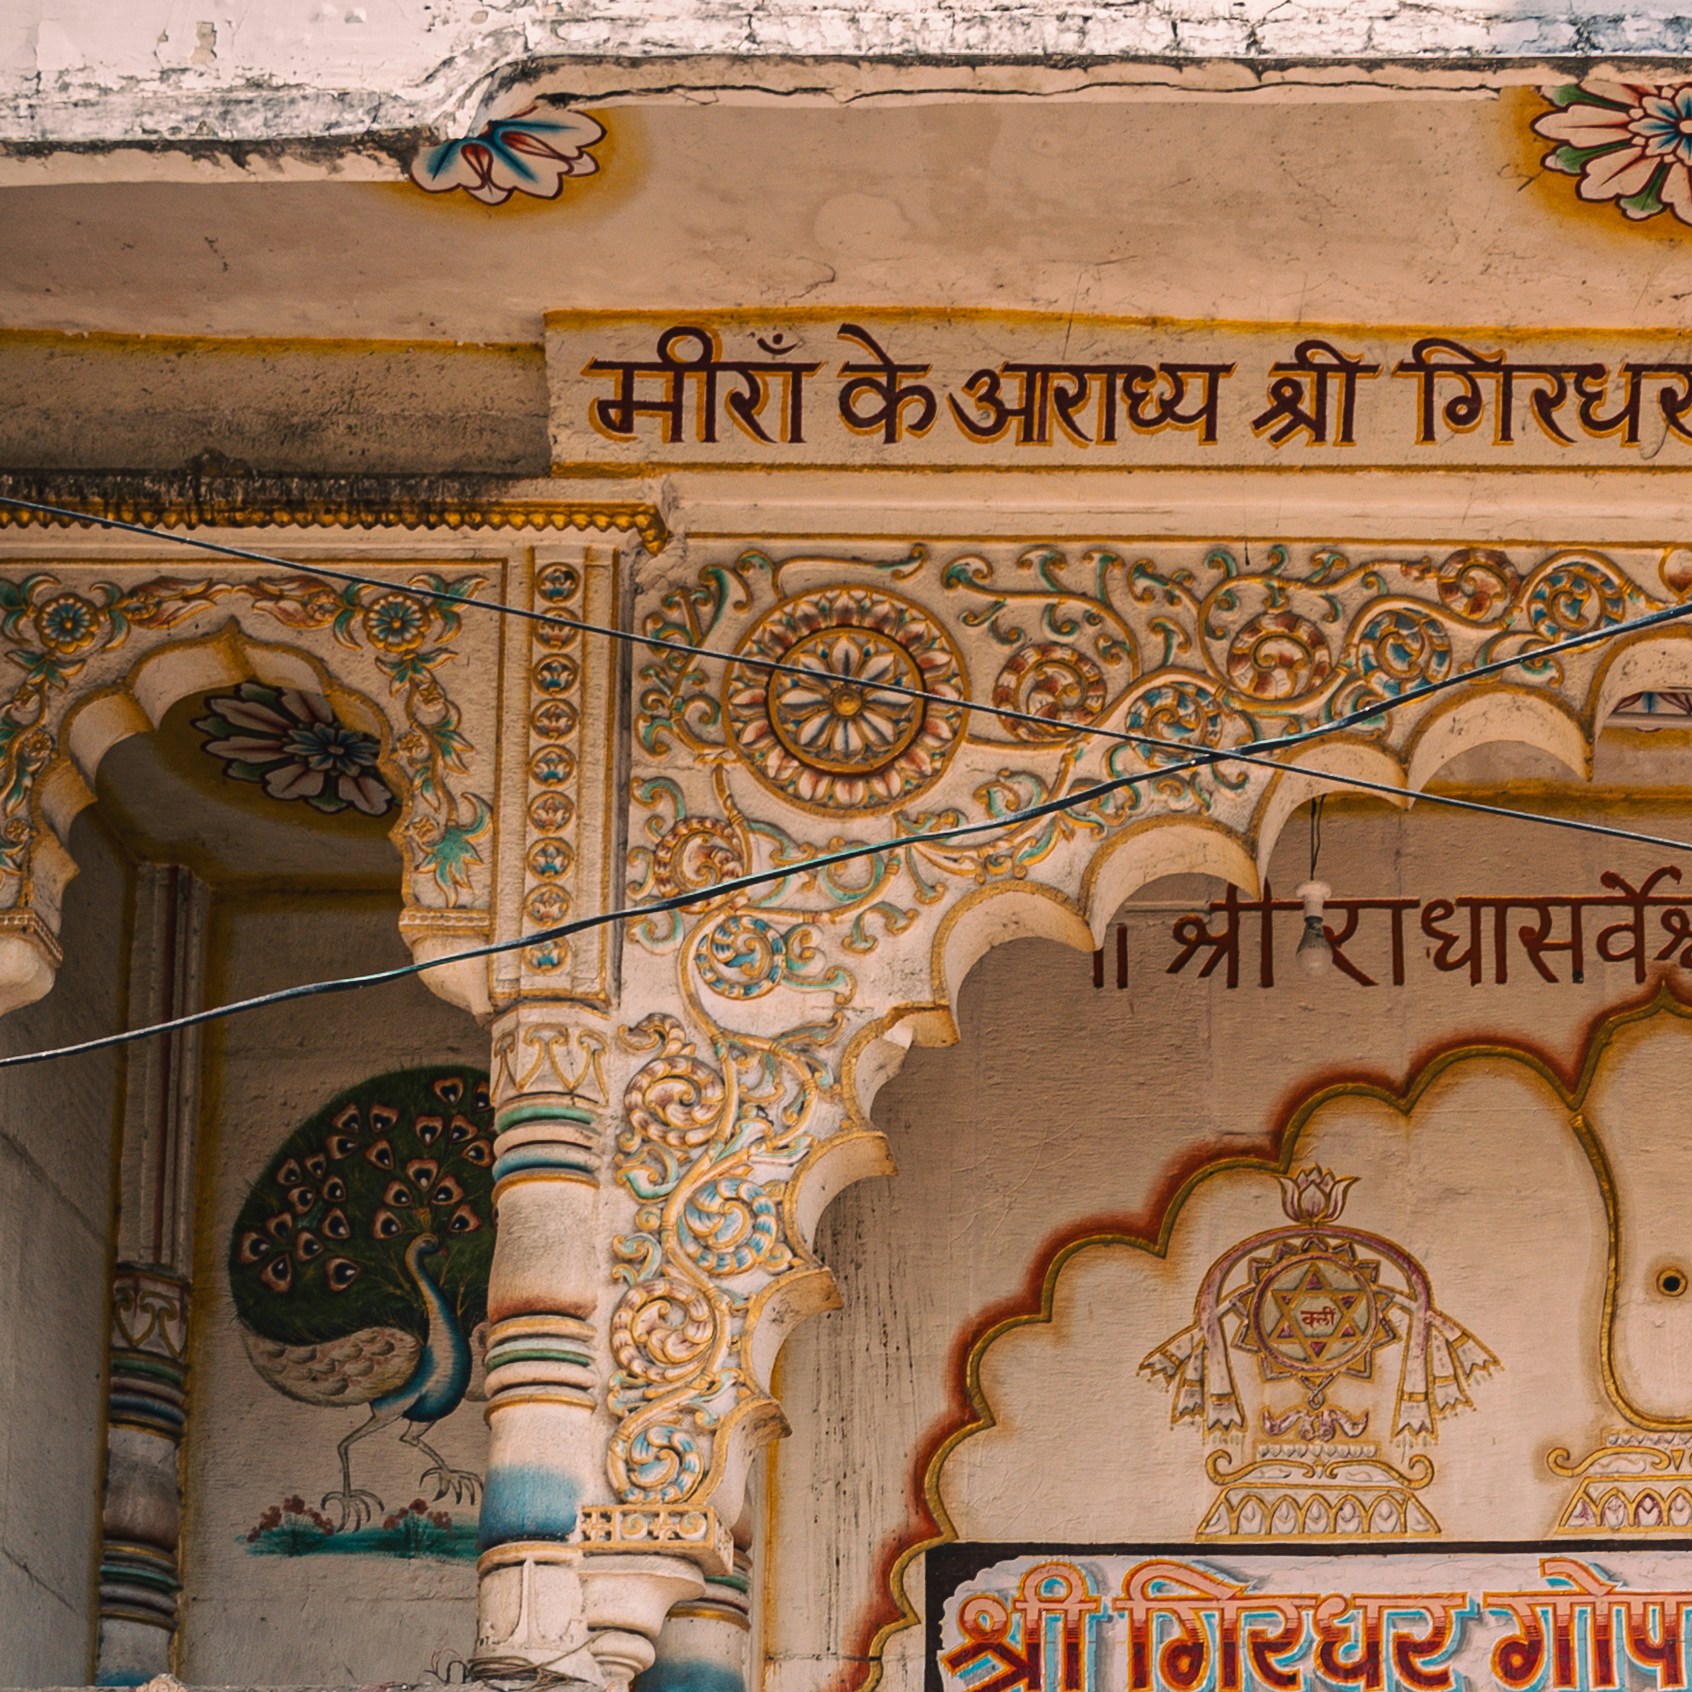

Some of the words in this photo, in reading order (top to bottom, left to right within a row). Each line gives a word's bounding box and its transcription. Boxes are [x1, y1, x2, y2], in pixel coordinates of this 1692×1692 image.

[836, 322, 936, 444] के
[948, 358, 1238, 448] आराध्य
[1251, 338, 1384, 448] श्री
